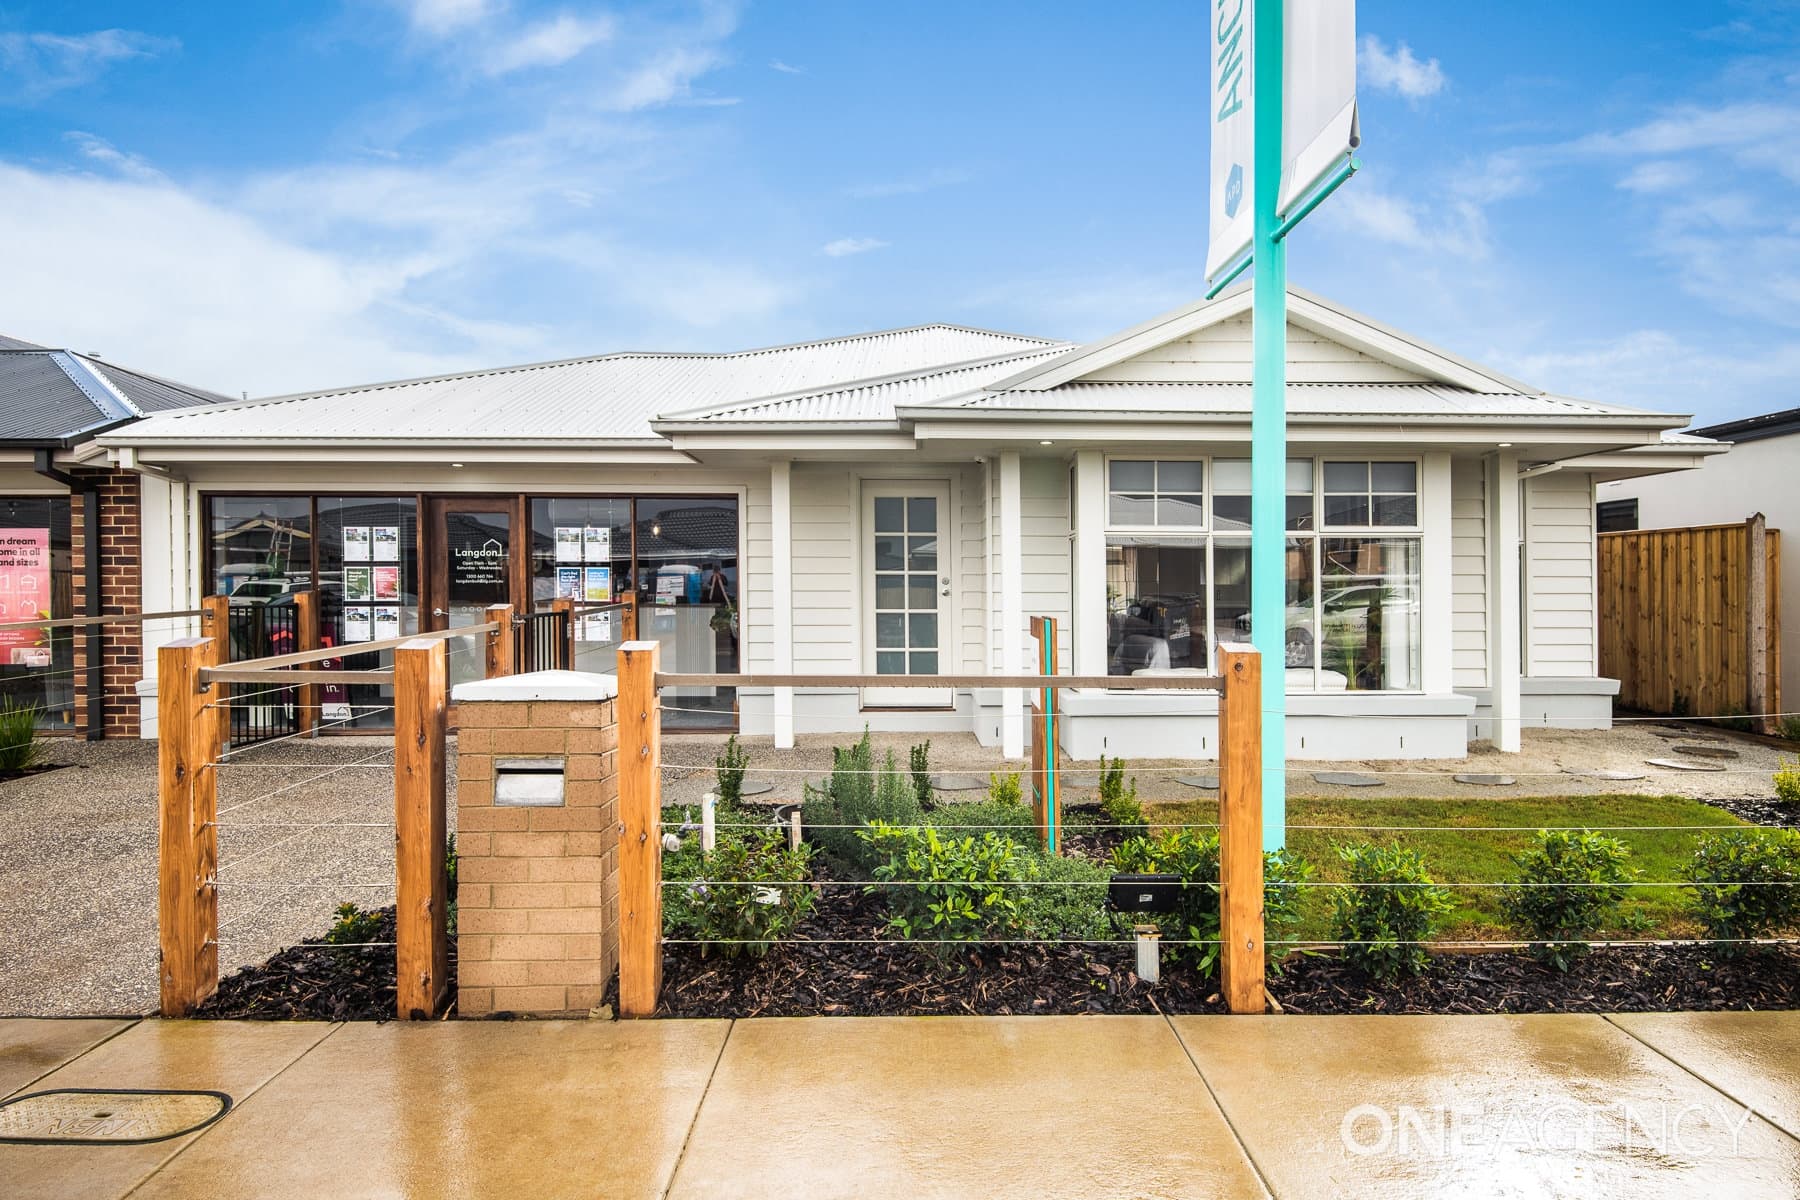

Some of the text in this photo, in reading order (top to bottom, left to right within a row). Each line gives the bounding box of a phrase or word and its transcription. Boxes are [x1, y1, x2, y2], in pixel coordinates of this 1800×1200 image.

[1217, 0, 1244, 123] ANC
[7, 536, 37, 545] dream
[19, 547, 27, 556] in
[29, 547, 40, 556] all
[455, 545, 499, 559] Langdon
[16, 558, 39, 566] sizes
